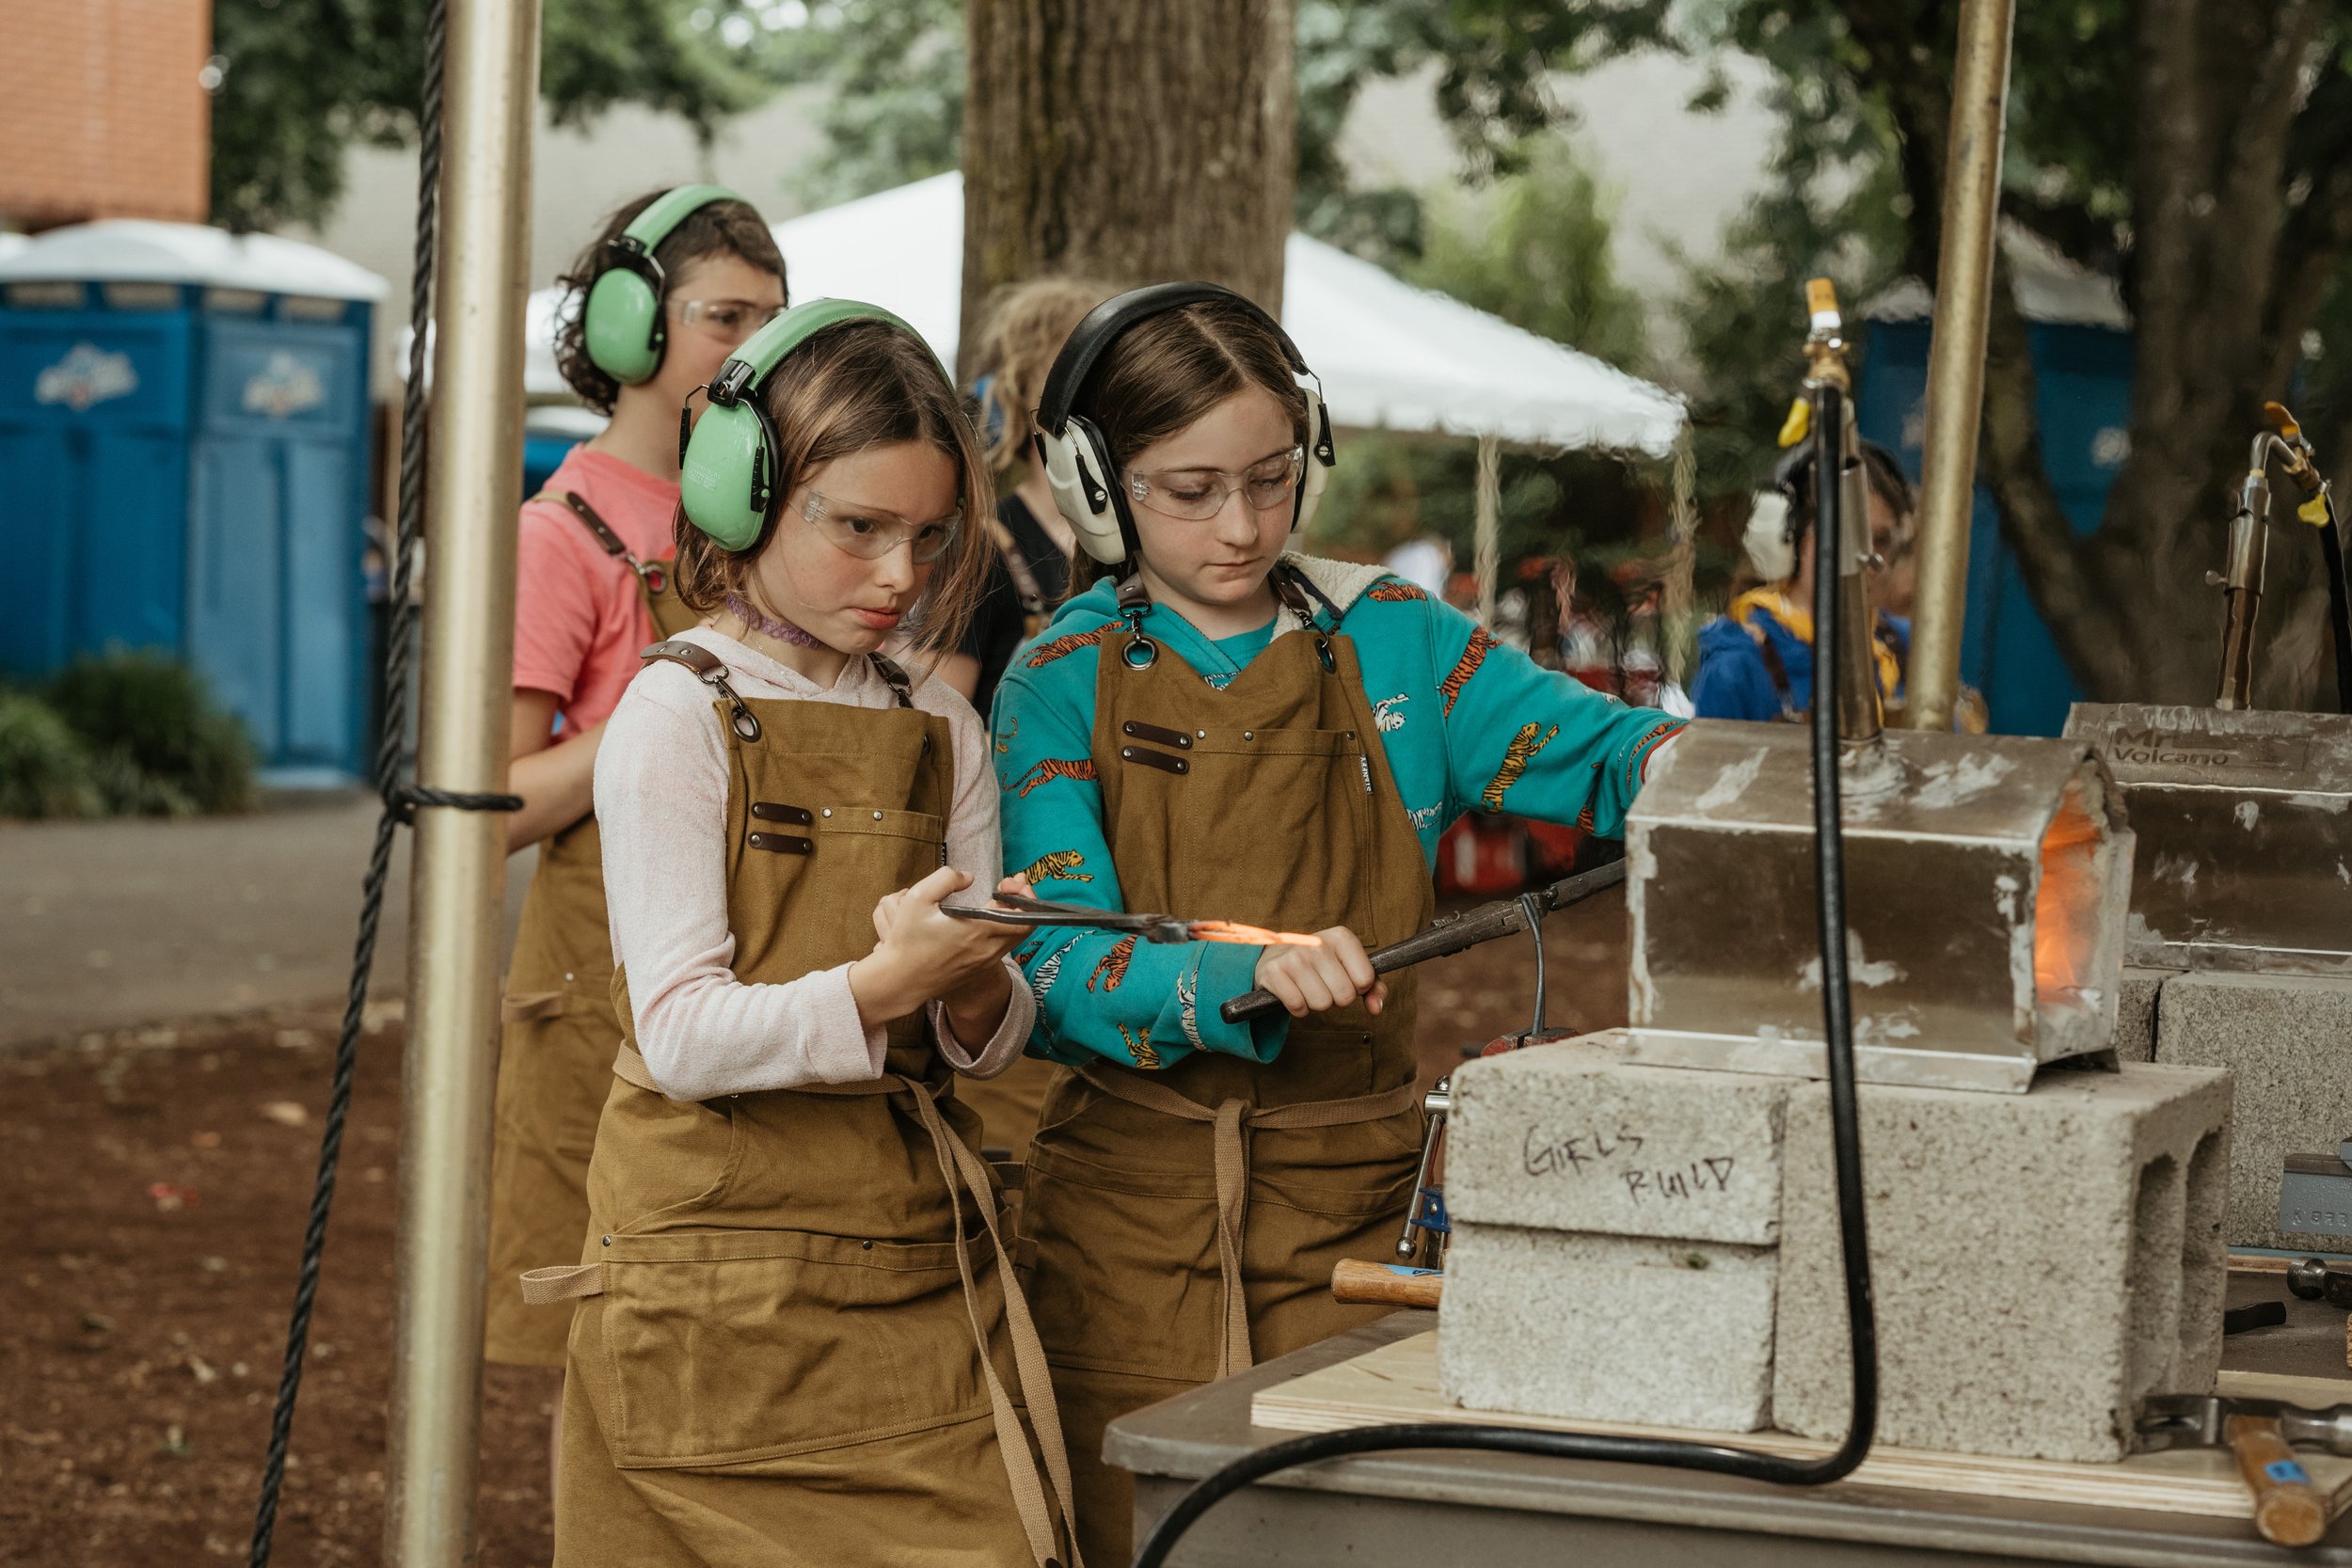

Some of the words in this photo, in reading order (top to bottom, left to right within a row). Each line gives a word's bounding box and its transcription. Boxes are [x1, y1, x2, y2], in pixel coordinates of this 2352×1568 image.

[2115, 728, 2174, 748] Mr
[2115, 749, 2229, 765] Volcano
[1523, 1124, 1643, 1176] GIRLS
